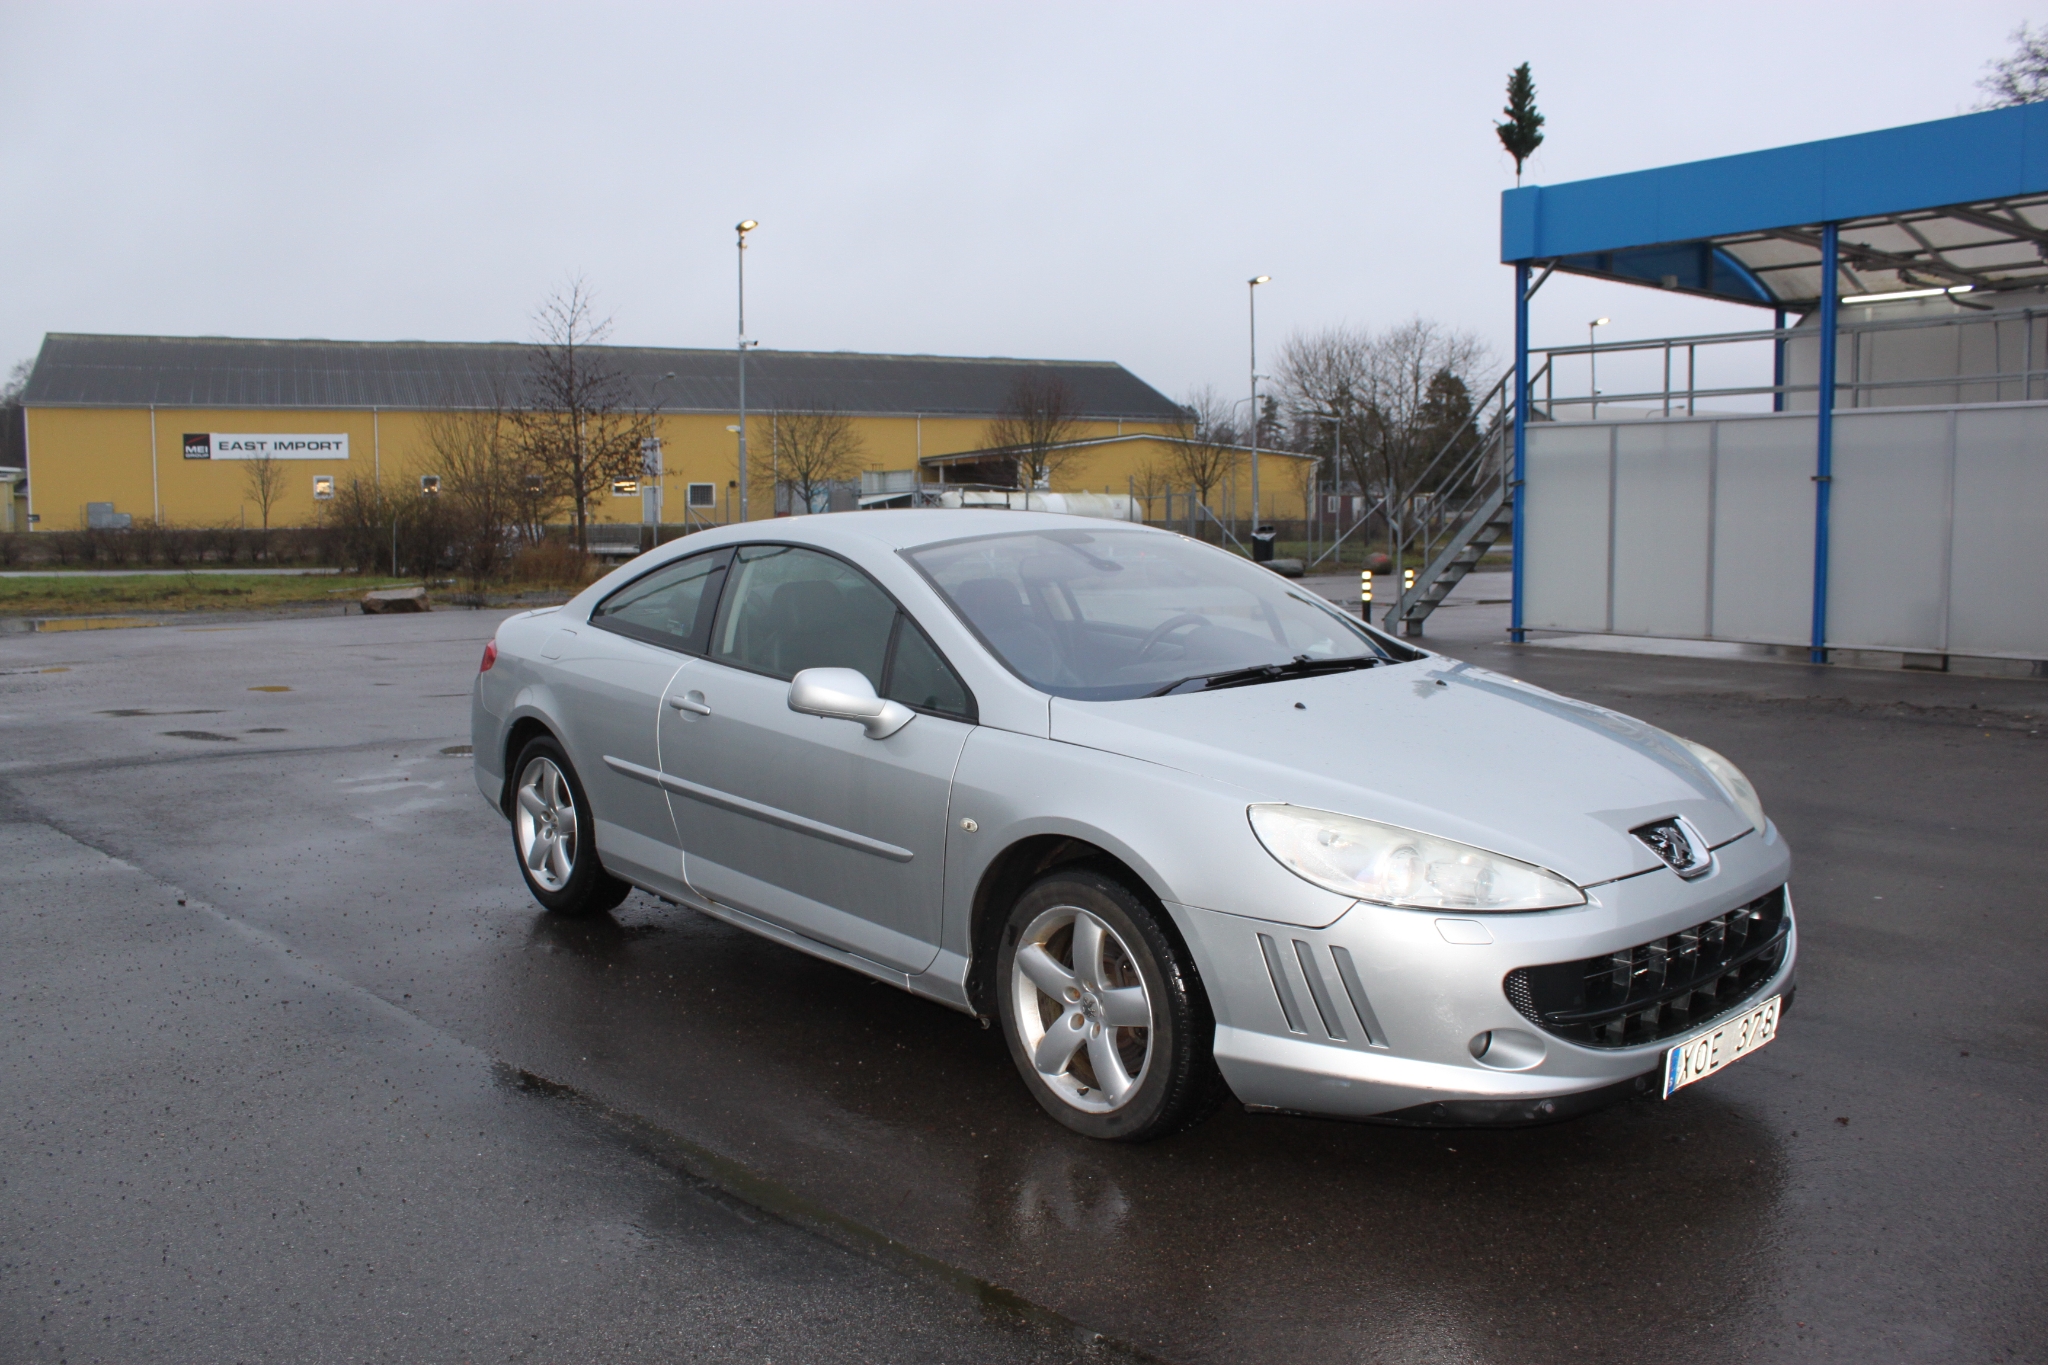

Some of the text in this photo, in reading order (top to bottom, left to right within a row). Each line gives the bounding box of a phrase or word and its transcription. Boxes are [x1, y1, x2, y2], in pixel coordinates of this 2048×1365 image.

[185, 445, 209, 454] MEI
[218, 441, 343, 451] EAST IMPORT
